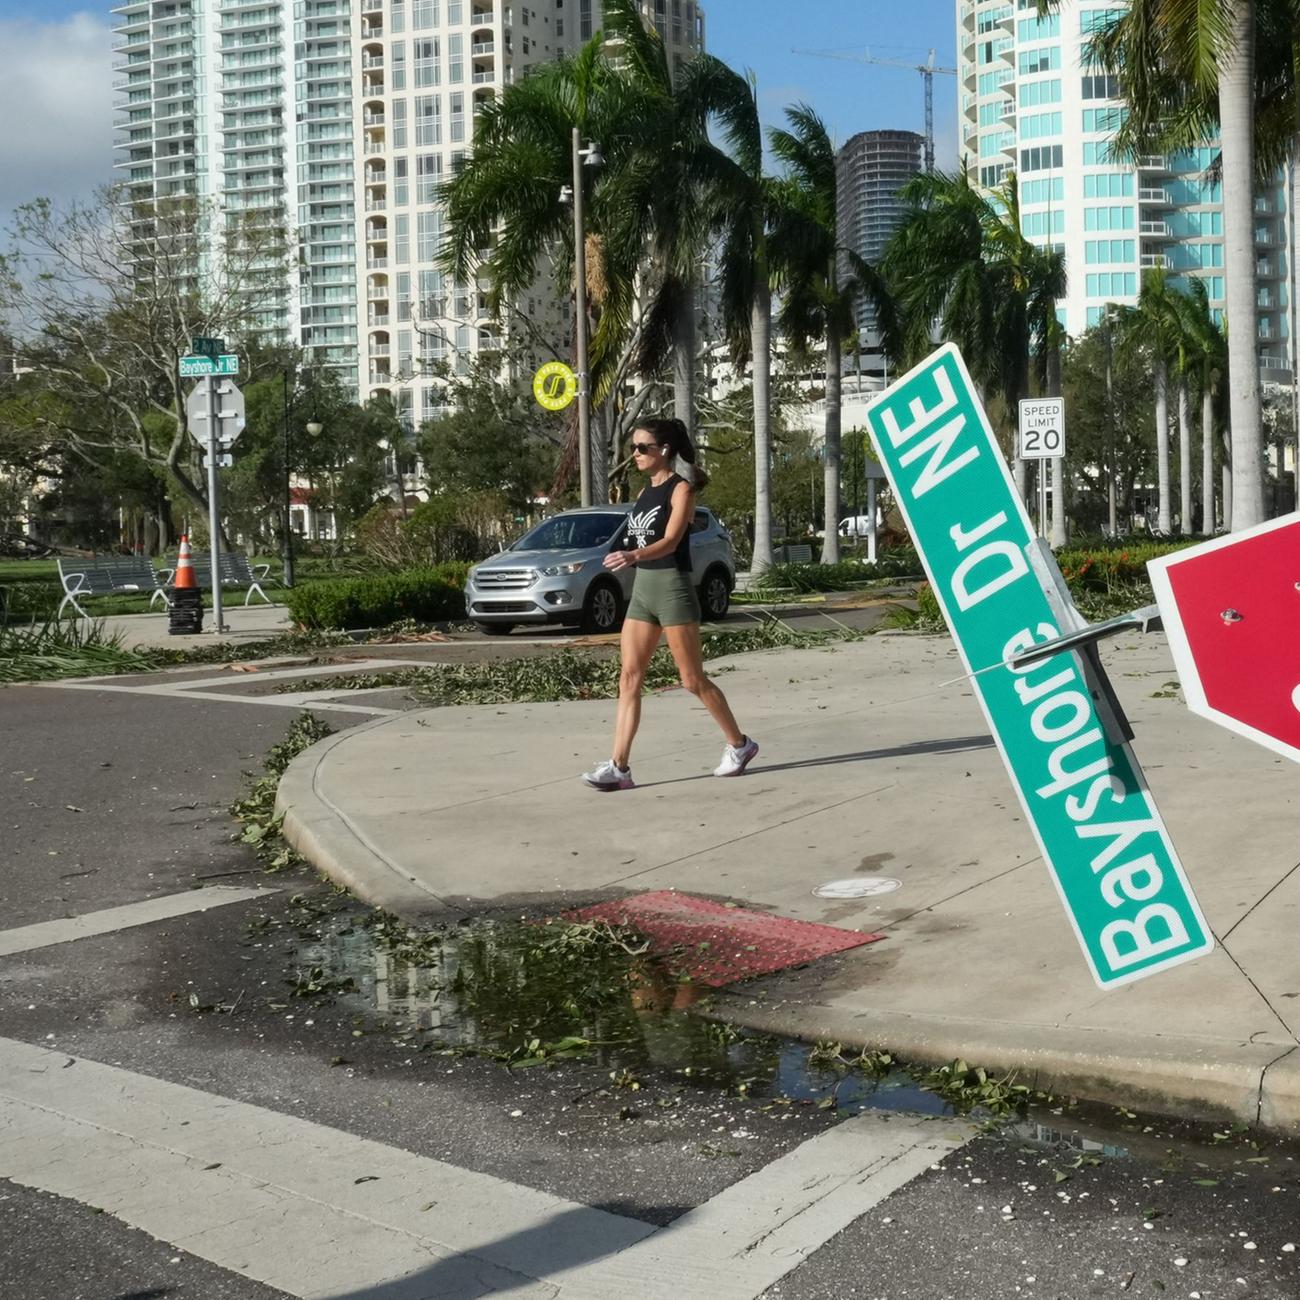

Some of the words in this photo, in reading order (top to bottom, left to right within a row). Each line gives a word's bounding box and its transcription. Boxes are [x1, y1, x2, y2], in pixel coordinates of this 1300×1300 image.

[193, 339, 199, 353] 2
[213, 341, 224, 354] NE
[180, 359, 212, 375] Bayshore
[226, 357, 237, 372] NE
[1024, 405, 1060, 416] SPEED
[880, 364, 981, 499] NE
[1028, 417, 1056, 427] LIMIT
[1025, 429, 1060, 451] 20
[949, 510, 1031, 612] Dr
[1008, 621, 1191, 971] Bayshore
